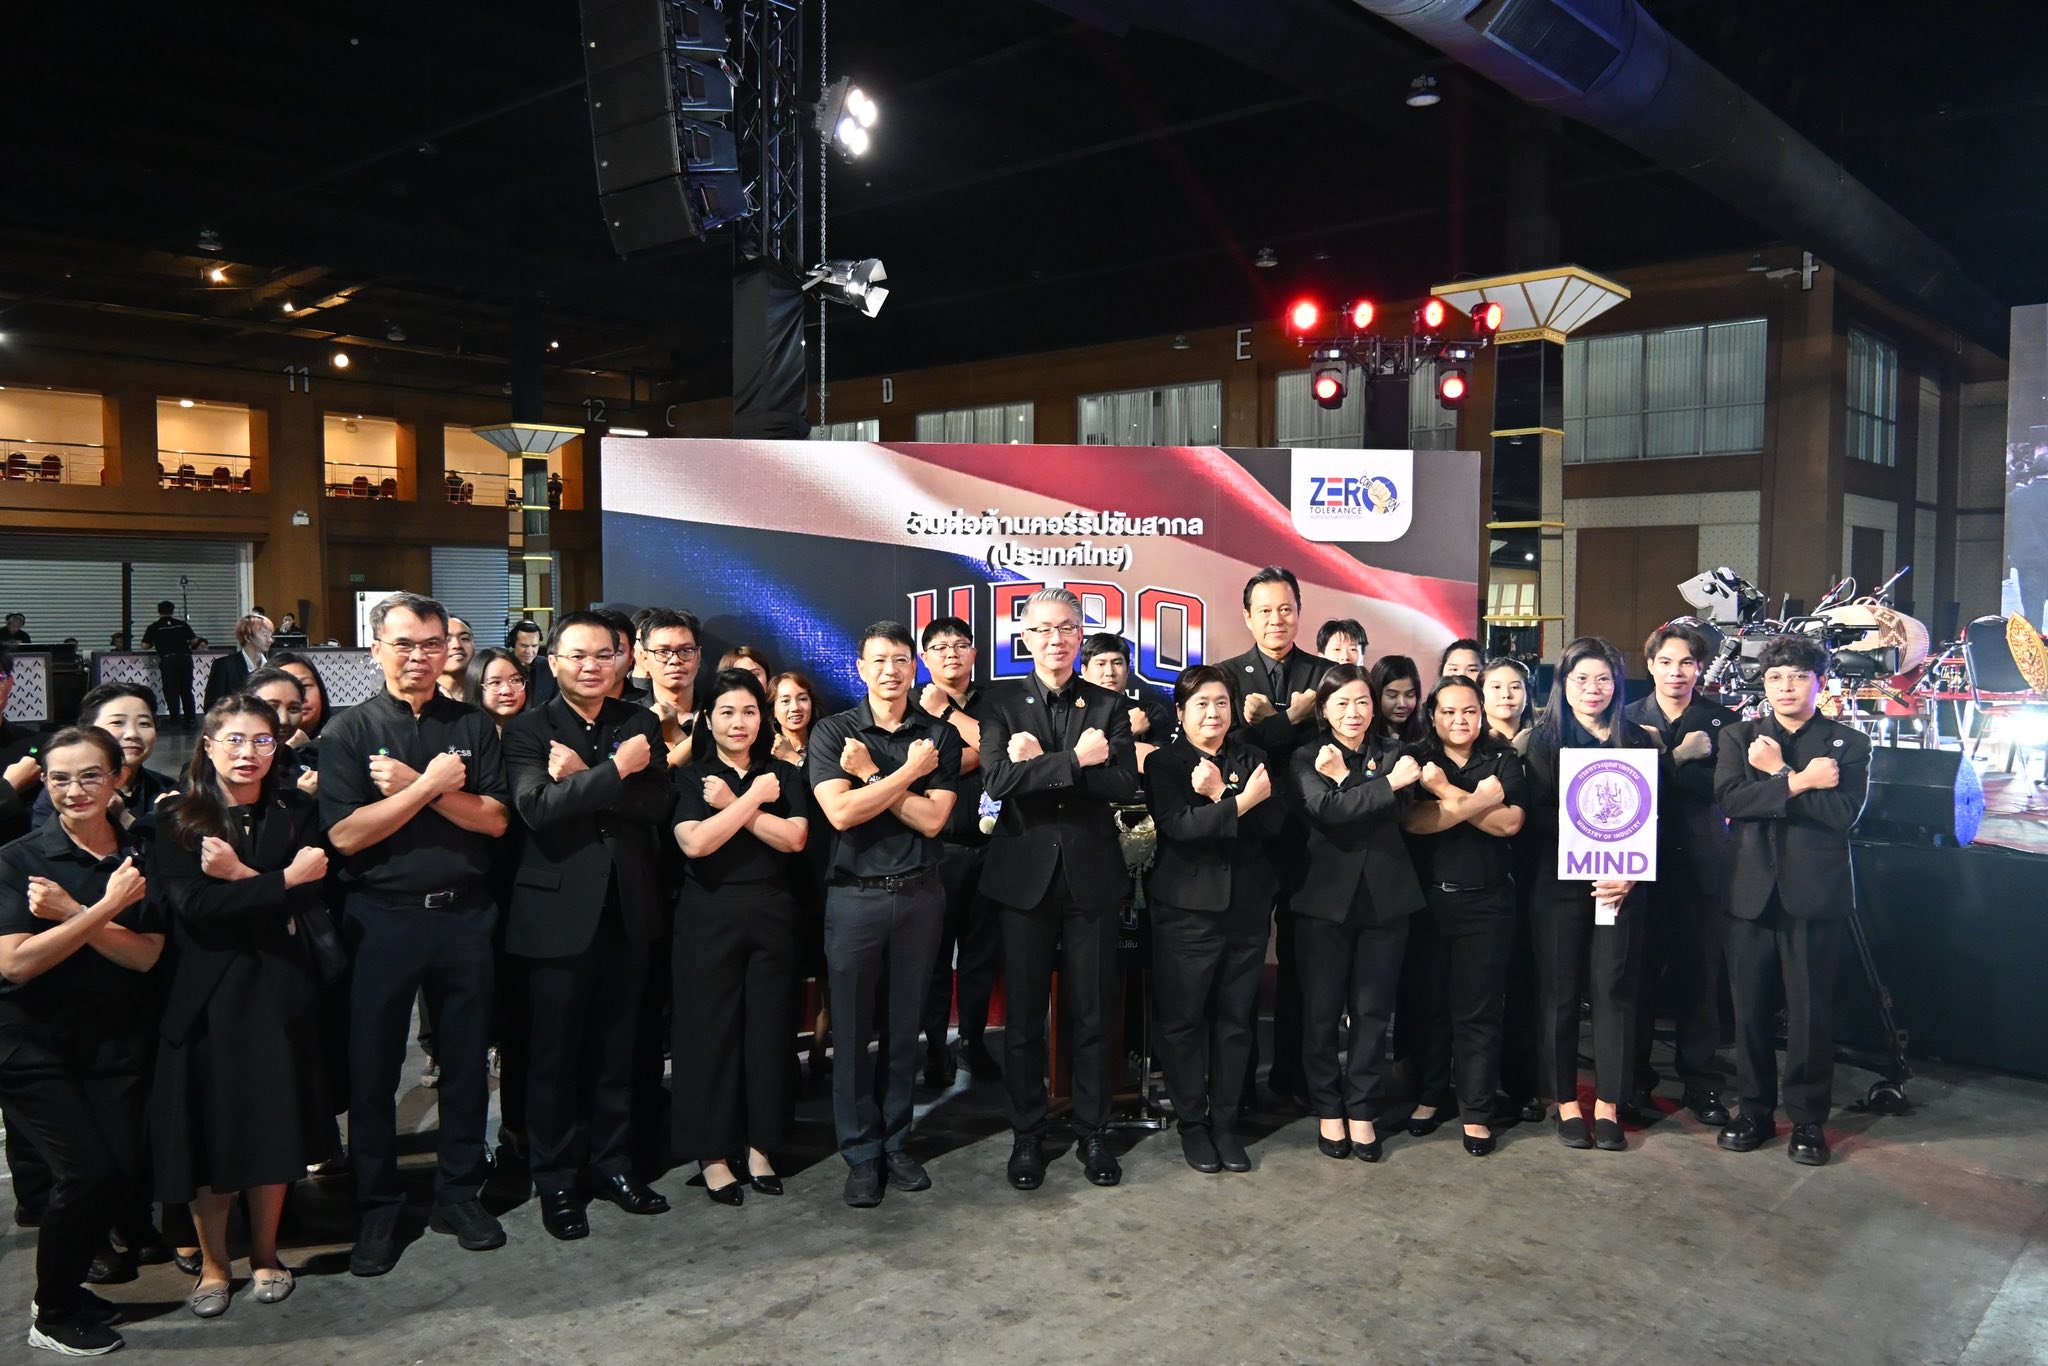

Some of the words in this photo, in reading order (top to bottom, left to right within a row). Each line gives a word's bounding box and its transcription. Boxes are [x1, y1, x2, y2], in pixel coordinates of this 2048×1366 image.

[1236, 328, 1253, 361] E
[282, 364, 310, 393] 11
[882, 377, 893, 403] D
[582, 398, 607, 423] 12
[665, 404, 677, 428] C
[1309, 476, 1398, 513] ZERO
[908, 508, 1204, 536] วันต่อต้านคอร์รัปชันสากล
[1309, 506, 1363, 515] TOLERANCE
[989, 540, 1133, 571] (ประเทศไทย)
[1576, 820, 1603, 839] MINISTRY
[1613, 820, 1642, 839] INDUSTRY
[1566, 850, 1649, 875] MIND
